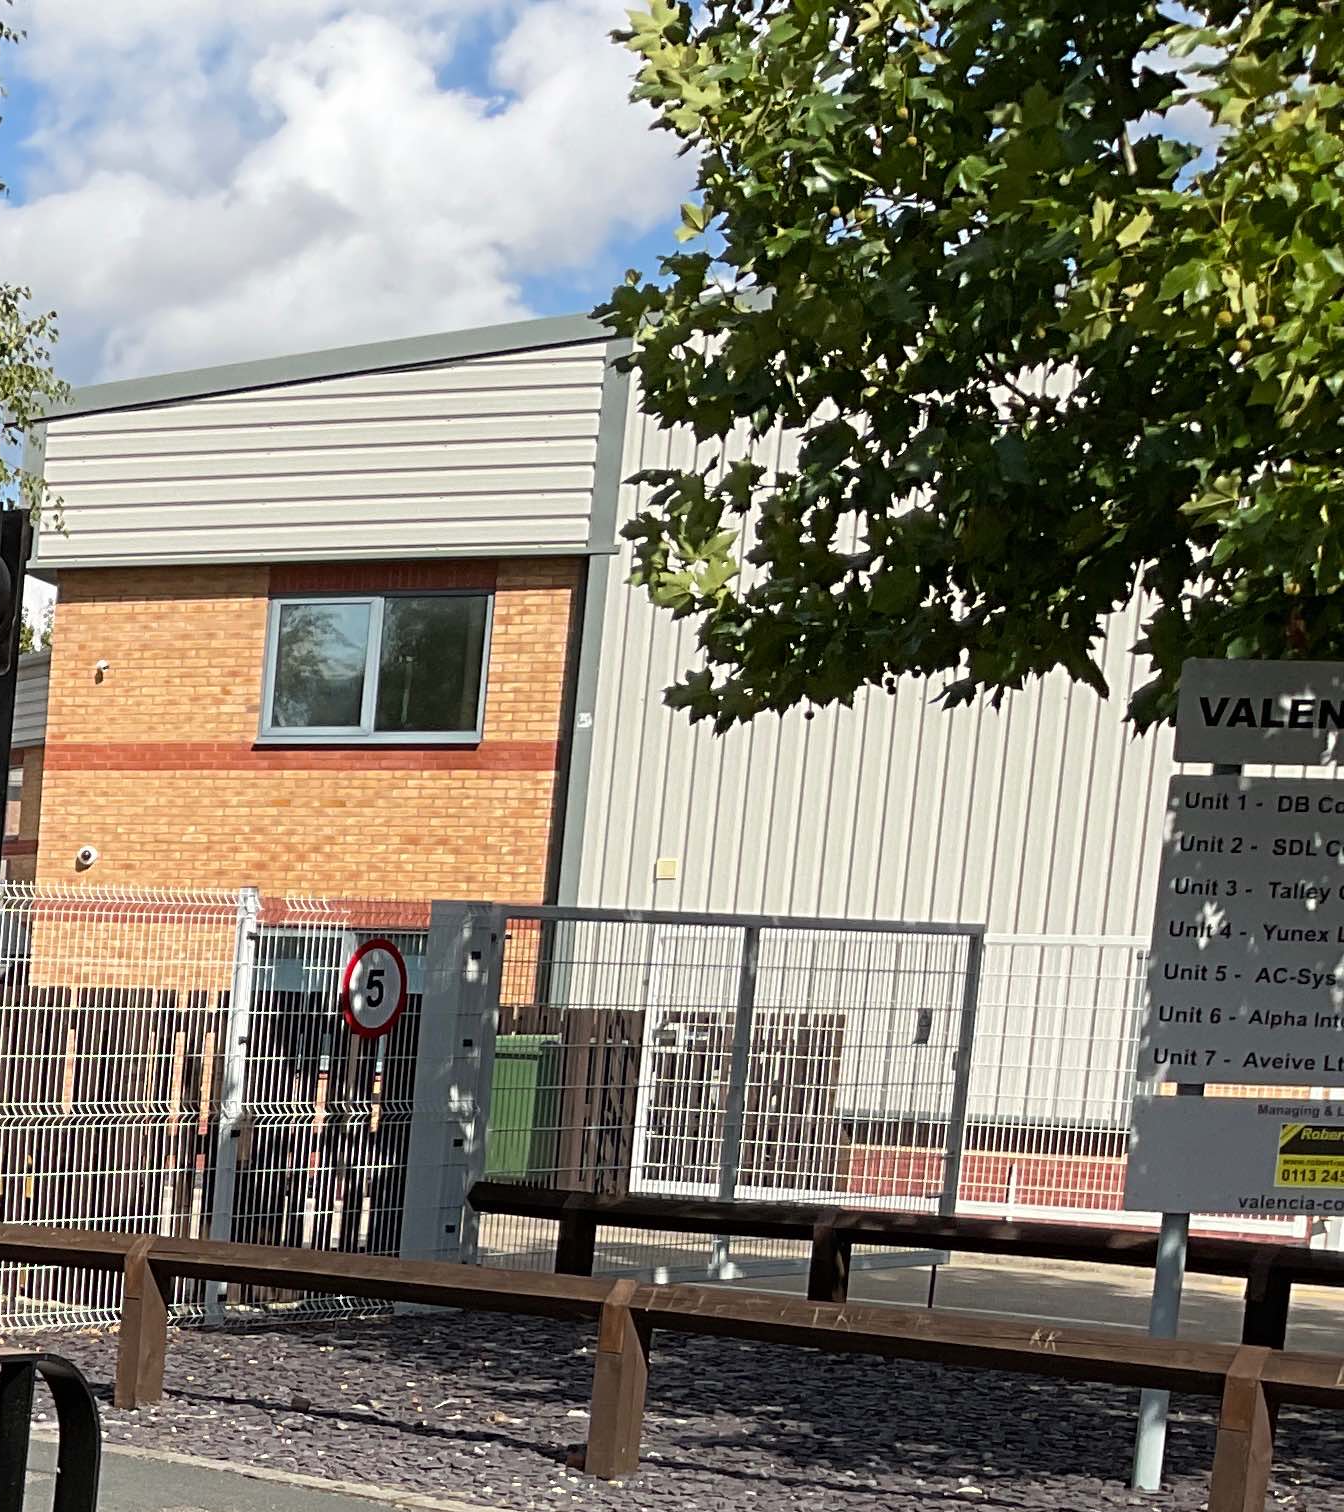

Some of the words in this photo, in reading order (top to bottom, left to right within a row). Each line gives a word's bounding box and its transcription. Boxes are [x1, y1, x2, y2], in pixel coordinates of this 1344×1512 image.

[1200, 697, 1344, 729] VALEN
[1185, 791, 1230, 811] Unit
[1238, 794, 1247, 811] 1
[1278, 795, 1310, 813] DB
[1180, 835, 1224, 853] Unit
[1230, 837, 1244, 854] 2
[1272, 838, 1317, 856] SDL
[1326, 840, 1344, 857] C
[1175, 877, 1218, 896] Unit
[1225, 880, 1237, 896] 3
[1269, 881, 1331, 904] Talley
[1169, 920, 1213, 938] Unit
[1220, 922, 1232, 939] 4
[1263, 924, 1329, 942] Yunex
[1164, 963, 1207, 981] Unit
[1215, 965, 1228, 982] 5
[366, 969, 385, 1008] 5
[1159, 1005, 1202, 1024] Unit
[1210, 1007, 1221, 1024] 6
[1248, 1009, 1307, 1029] Alpha
[1154, 1047, 1197, 1065] Unit
[1205, 1050, 1216, 1066] 7
[1242, 1052, 1316, 1070] Aveive
[1257, 1104, 1320, 1118] Managing
[1324, 1105, 1333, 1116] &
[1281, 1168, 1316, 1183] 0113
[1321, 1170, 1344, 1183] 245
[1238, 1194, 1344, 1211] valencia-co
